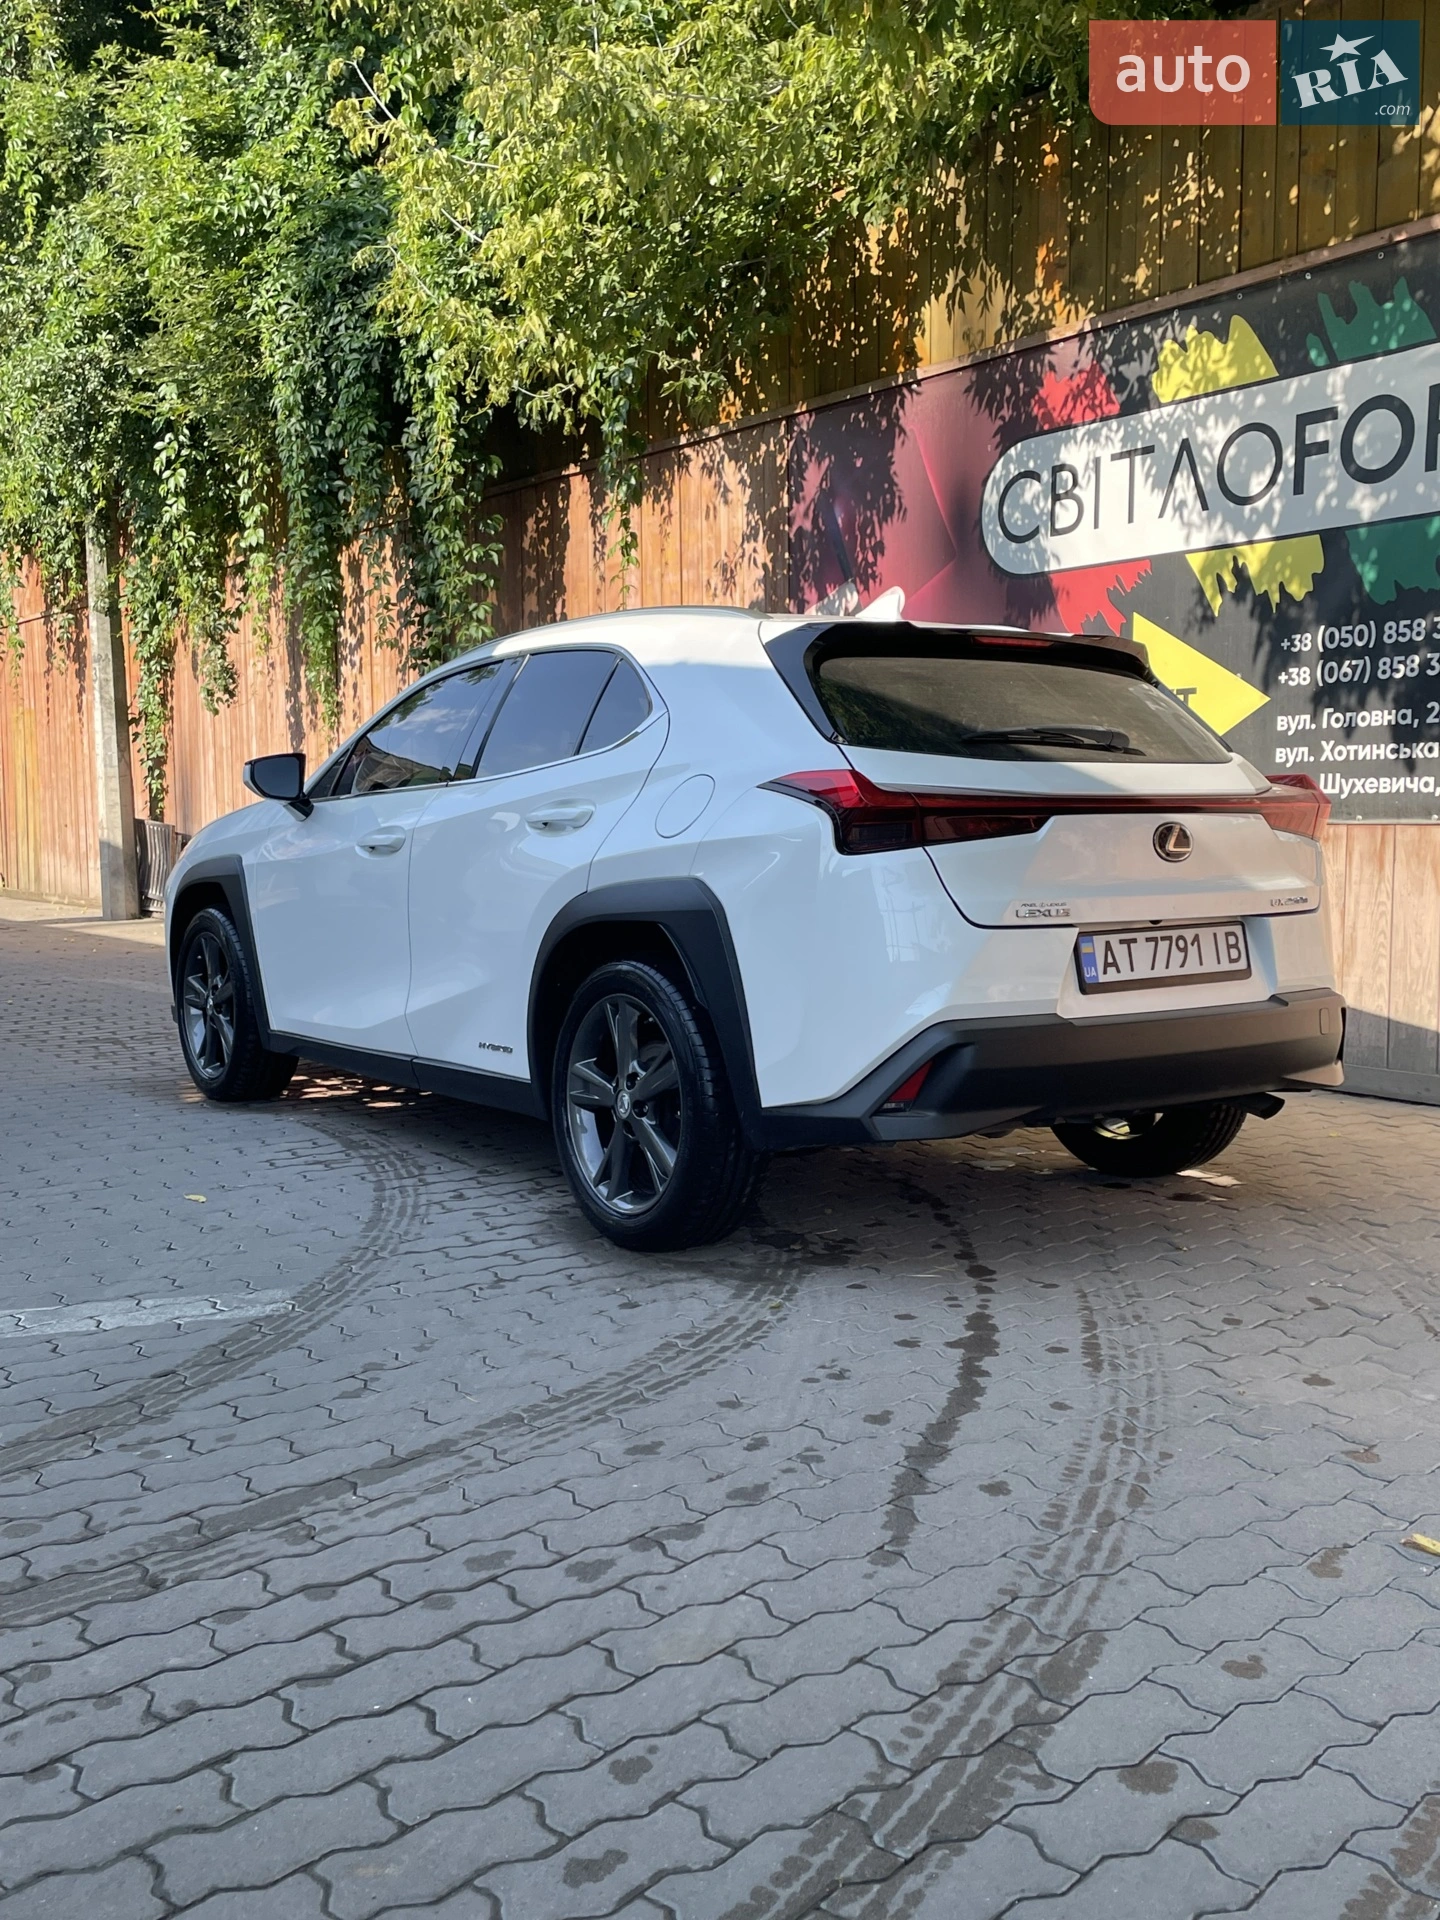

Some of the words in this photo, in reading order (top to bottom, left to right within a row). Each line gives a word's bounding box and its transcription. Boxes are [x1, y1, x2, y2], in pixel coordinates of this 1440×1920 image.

[1281, 633, 1312, 652] +38
[1317, 621, 1377, 653] (050)
[1383, 618, 1426, 644] 858
[1278, 667, 1311, 686] +38
[1316, 656, 1371, 686] (067)
[1377, 654, 1420, 680] 858
[1276, 713, 1316, 736] вул.
[1322, 707, 1419, 729] Головна,
[1275, 746, 1315, 768] вул.
[1320, 740, 1440, 762] Хотинська
[1016, 909, 1071, 918] LEXUS
[1084, 966, 1097, 978] UA
[1103, 938, 1138, 975] AT
[1145, 933, 1204, 971] 7791
